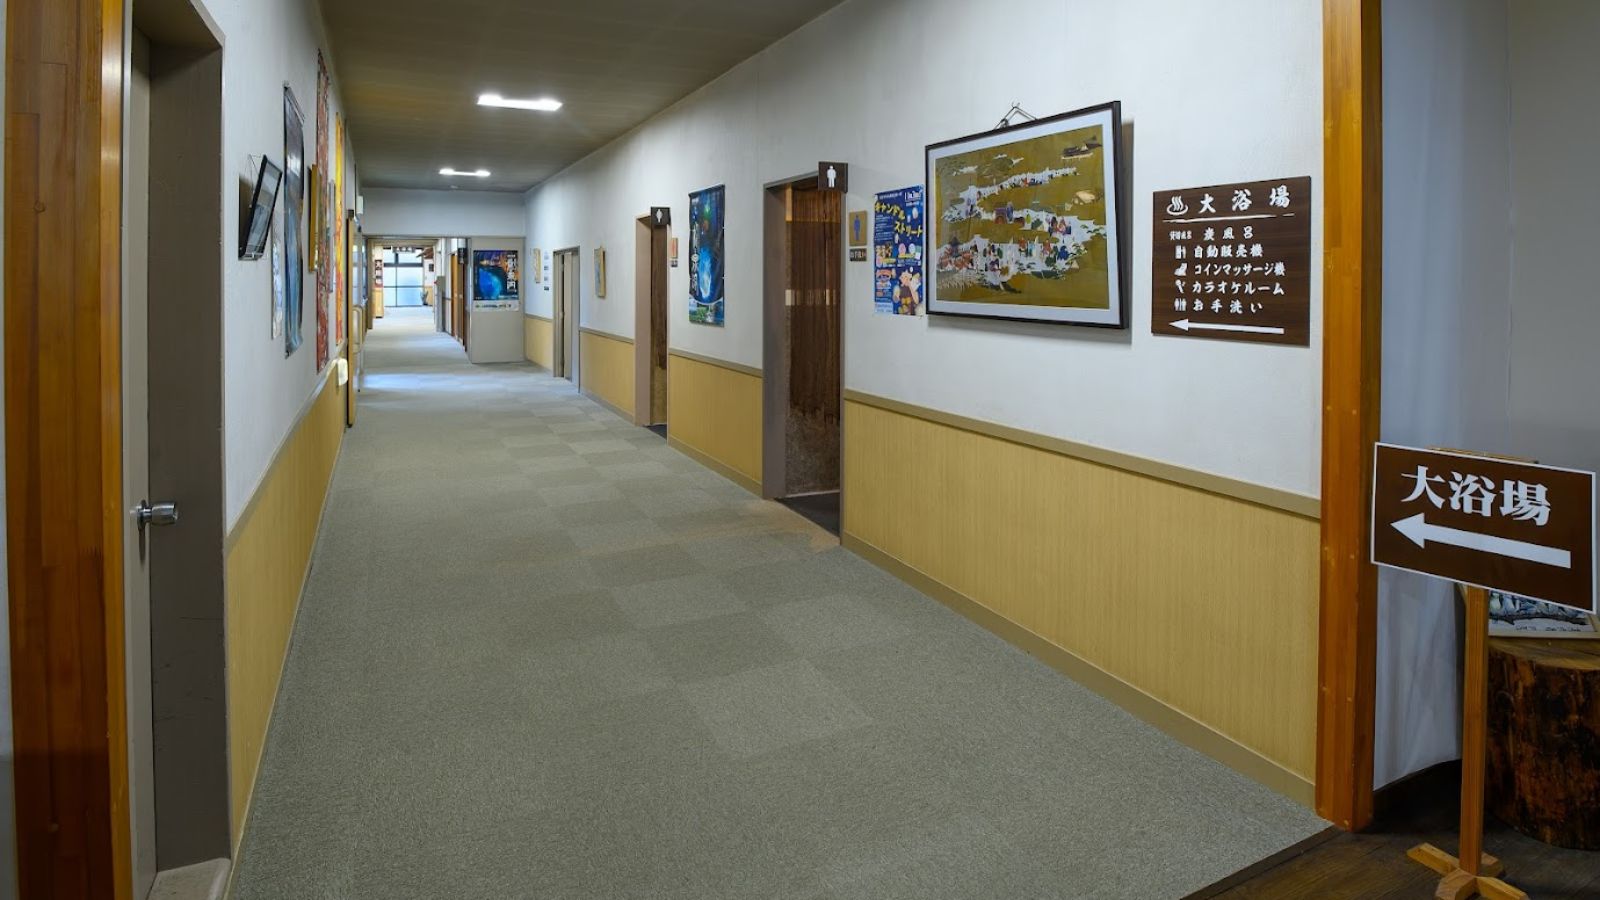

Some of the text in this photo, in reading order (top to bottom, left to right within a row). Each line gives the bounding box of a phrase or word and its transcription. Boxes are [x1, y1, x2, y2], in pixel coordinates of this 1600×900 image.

[1198, 184, 1291, 214] 大浴場
[1193, 243, 1264, 259] 自動販売機
[1194, 261, 1286, 277] コインマッサージ機
[1192, 281, 1285, 295] カラオケルーム
[1193, 298, 1263, 314] お手洗い
[1401, 465, 1551, 526] 大浴場
